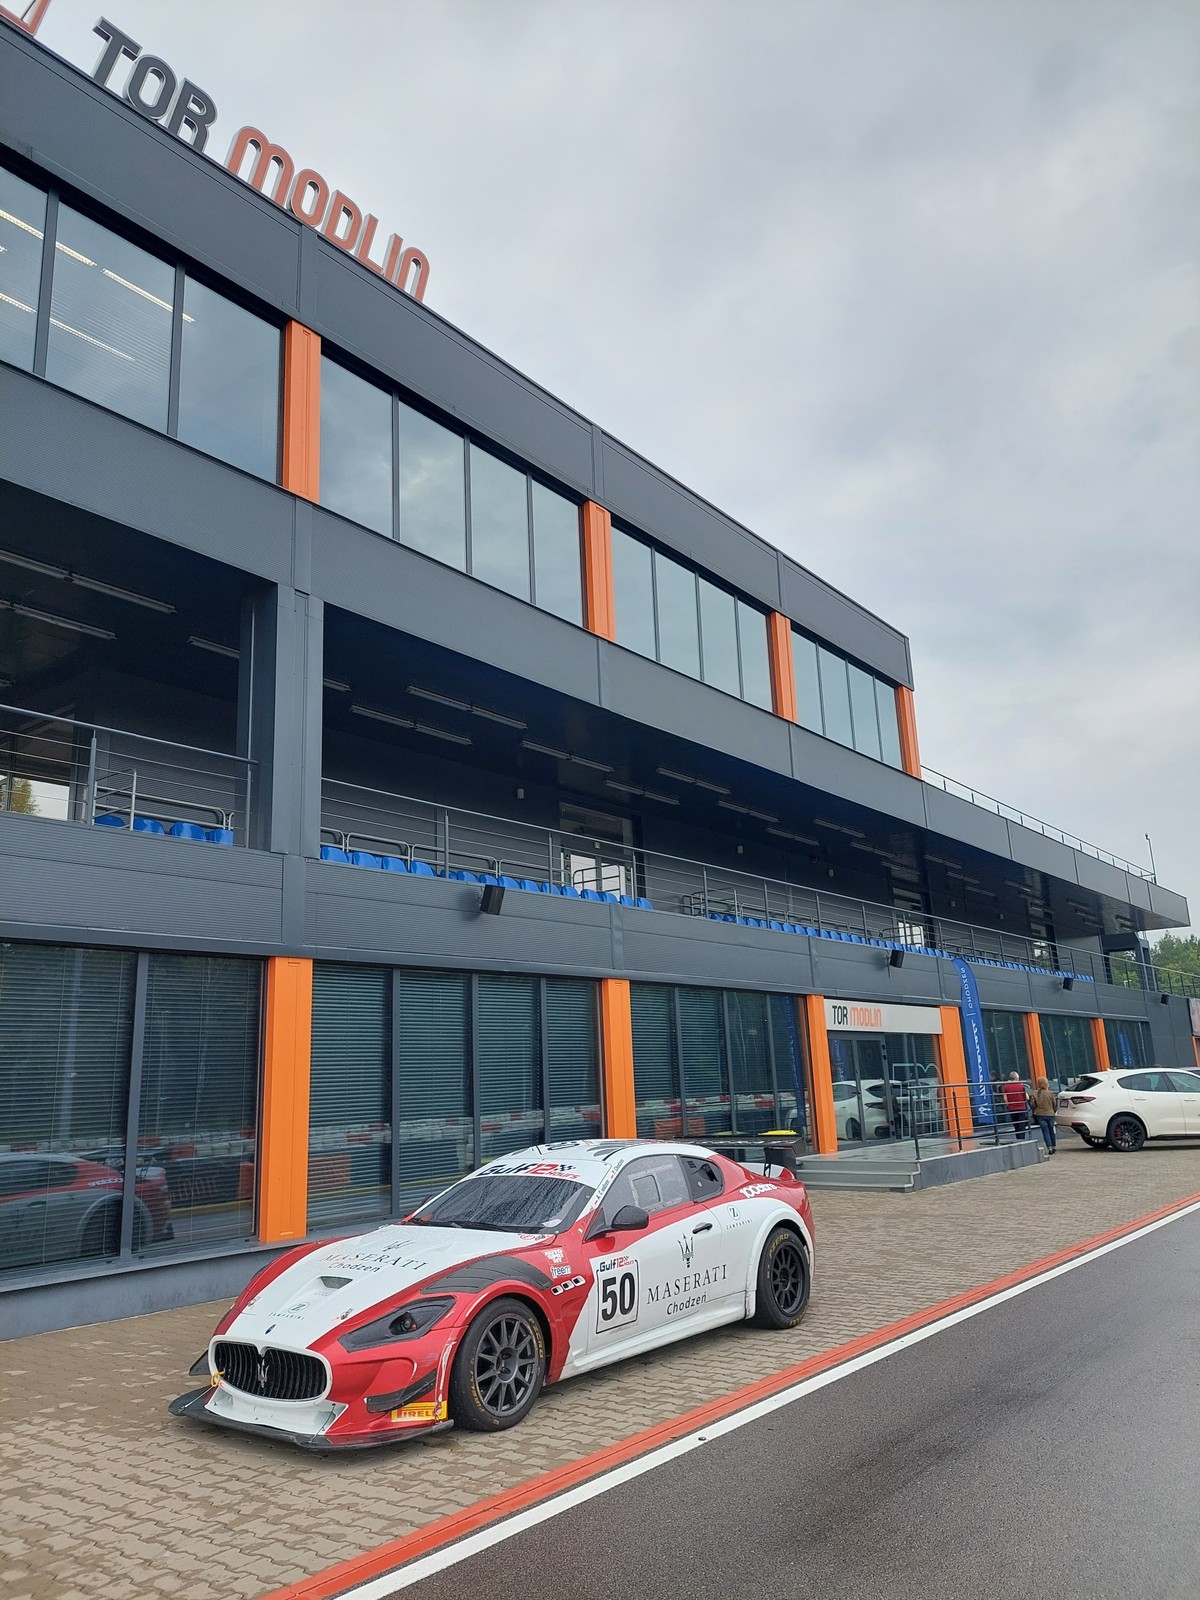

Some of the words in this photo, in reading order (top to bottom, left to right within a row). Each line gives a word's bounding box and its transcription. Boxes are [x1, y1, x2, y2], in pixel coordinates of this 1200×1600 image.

[92, 16, 218, 153] TOR
[224, 126, 430, 302] MODLIN
[831, 1005, 849, 1026] TOR
[850, 1007, 882, 1027] MODLIN
[601, 1272, 635, 1321] 50
[646, 1264, 727, 1304] MASERATI
